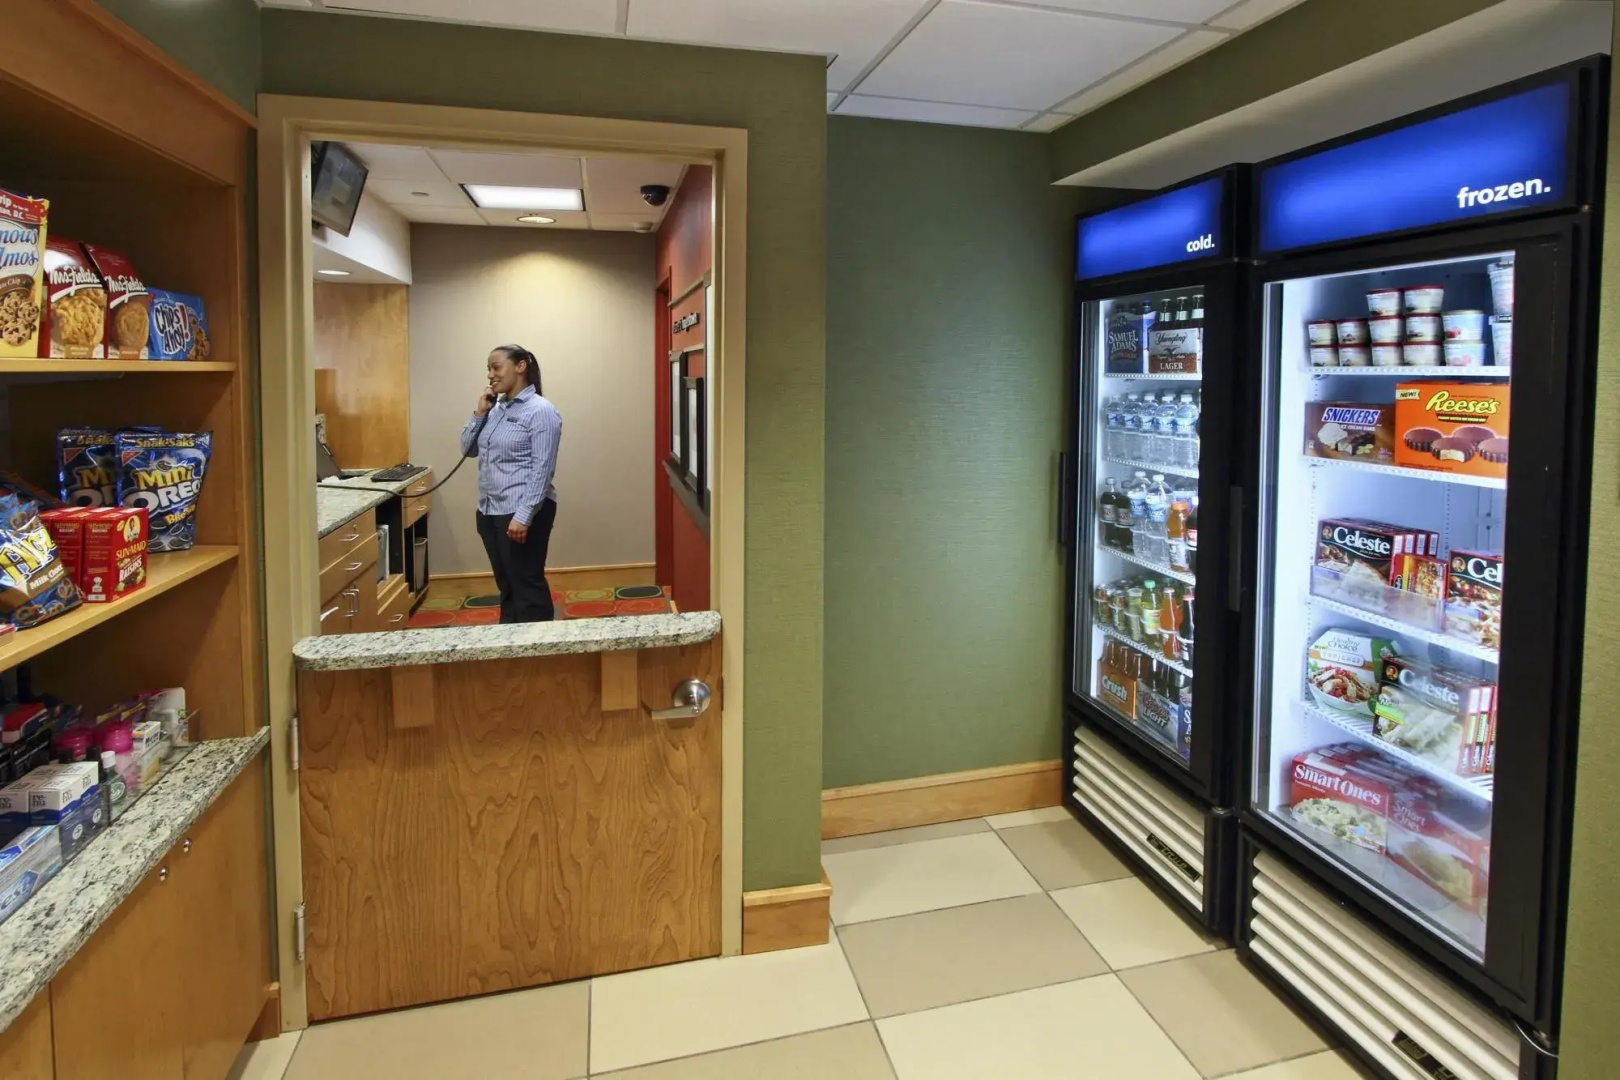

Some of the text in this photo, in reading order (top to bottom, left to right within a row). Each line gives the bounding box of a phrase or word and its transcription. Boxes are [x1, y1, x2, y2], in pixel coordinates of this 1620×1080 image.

[1456, 178, 1552, 209] frozen.
[1186, 233, 1216, 252] cold.
[1108, 330, 1139, 344] SAMUEL
[1111, 340, 1137, 353] ADAMS
[1160, 362, 1183, 370] LAGER
[1425, 390, 1500, 414] Reese's
[1323, 407, 1379, 424] SNICKERS
[136, 466, 193, 490] Mini
[1333, 526, 1391, 555] Celeste
